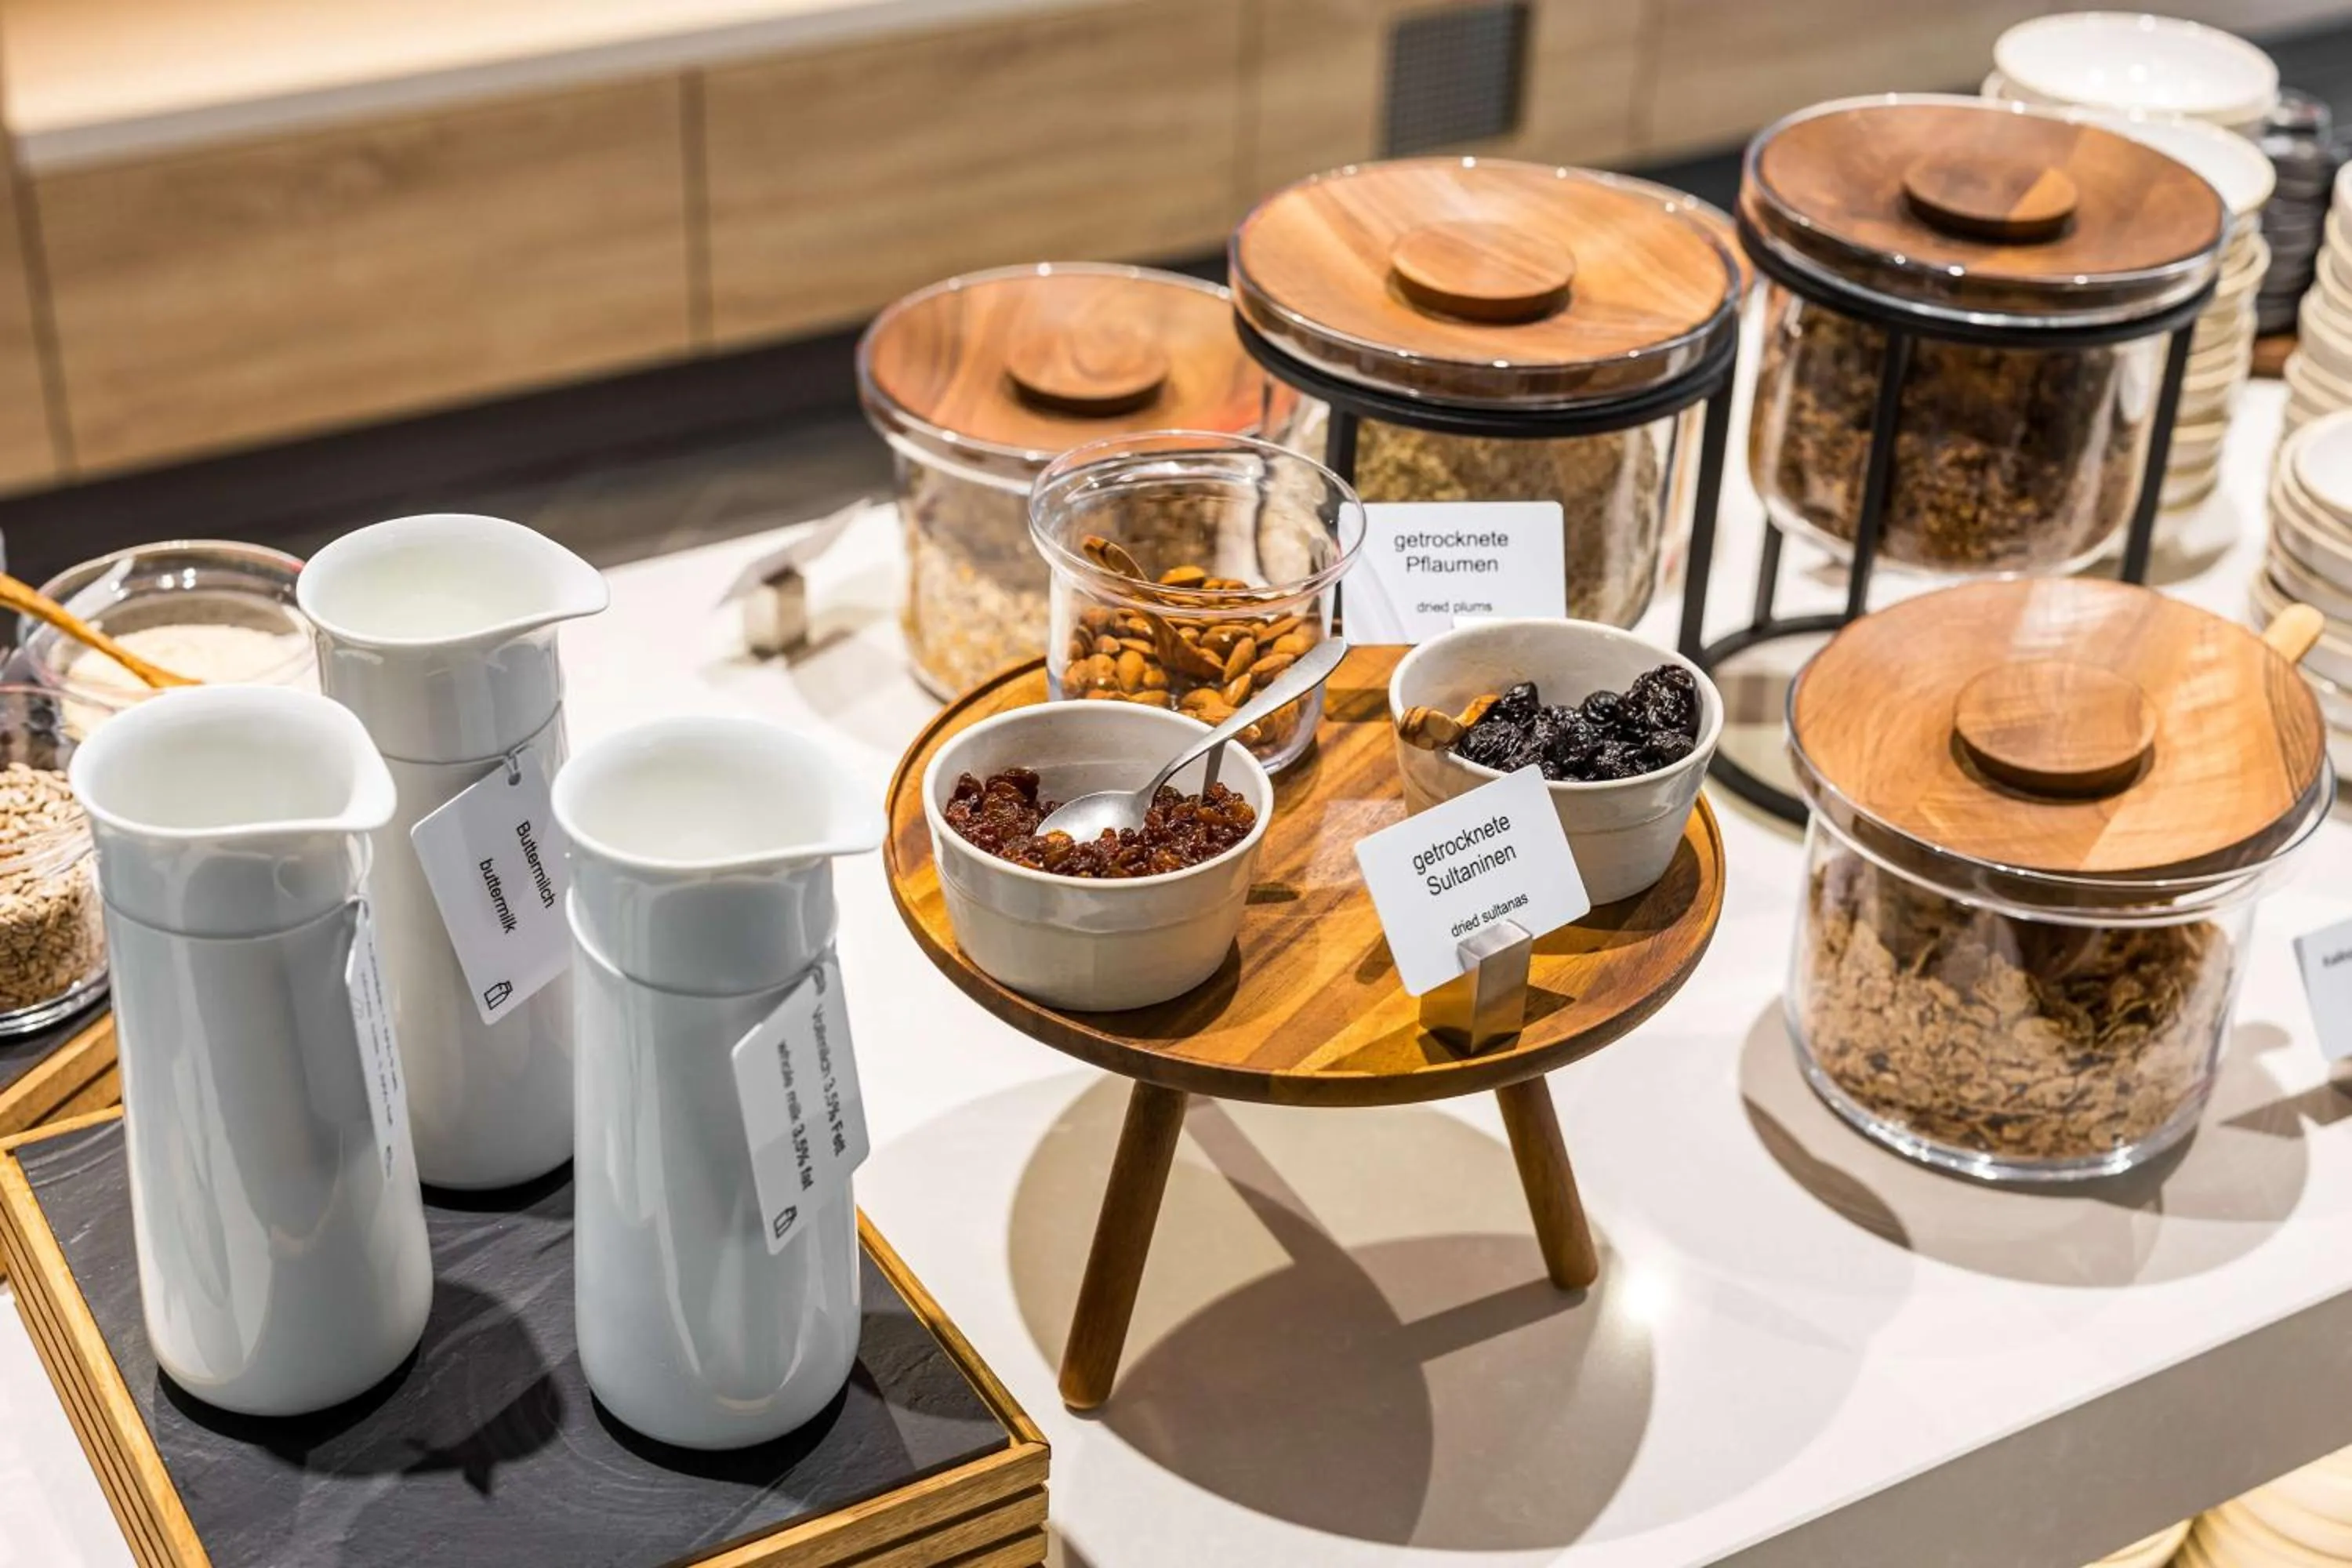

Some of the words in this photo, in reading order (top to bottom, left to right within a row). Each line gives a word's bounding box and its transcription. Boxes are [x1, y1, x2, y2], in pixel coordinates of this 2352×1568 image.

[1394, 530, 1508, 552] getrocknete
[1406, 556, 1498, 573] Pflaumen
[1417, 601, 1450, 613] dried
[1454, 601, 1493, 615] plums
[516, 820, 554, 909] Buttermilch
[1413, 815, 1511, 876] getrocknete
[1426, 844, 1517, 896] Sultaninen
[479, 858, 517, 934] buttermilk
[1450, 914, 1480, 938] dried
[1482, 892, 1529, 924] sultanas
[778, 1040, 793, 1089] whole
[786, 1090, 802, 1124] milk
[800, 1165, 815, 1191] fat
[831, 1120, 847, 1157] Fett
